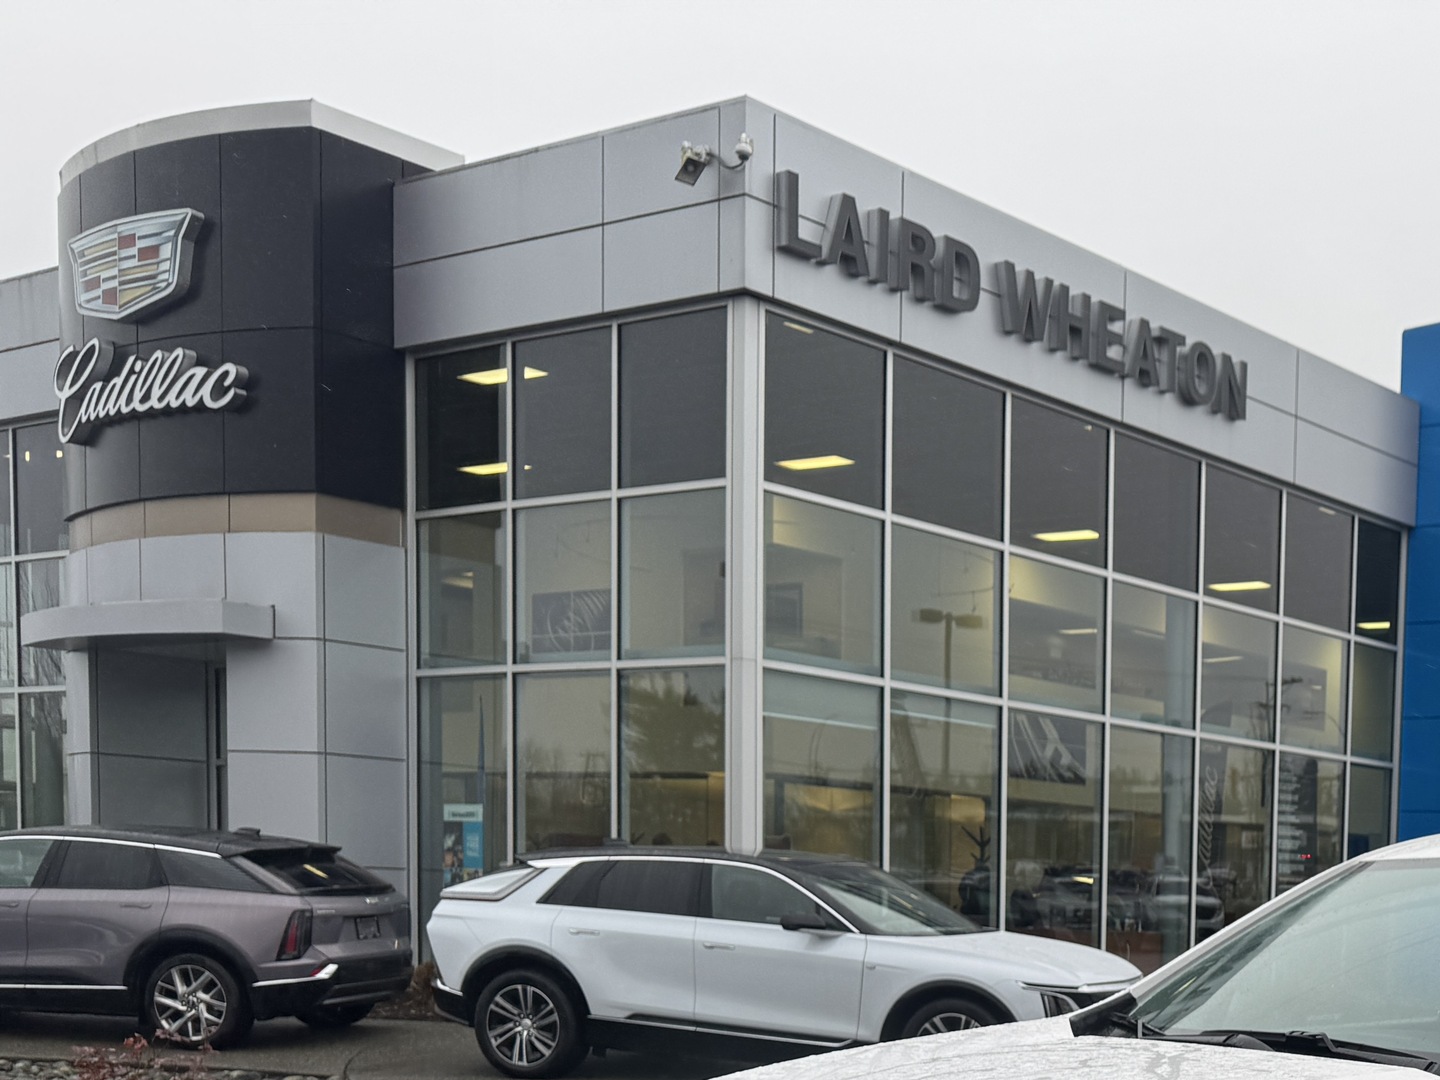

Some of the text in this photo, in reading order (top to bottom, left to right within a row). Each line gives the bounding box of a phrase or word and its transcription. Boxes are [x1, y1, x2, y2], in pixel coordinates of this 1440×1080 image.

[776, 169, 1248, 421] LAIRD WHEATON
[54, 337, 249, 443] Cadillac
